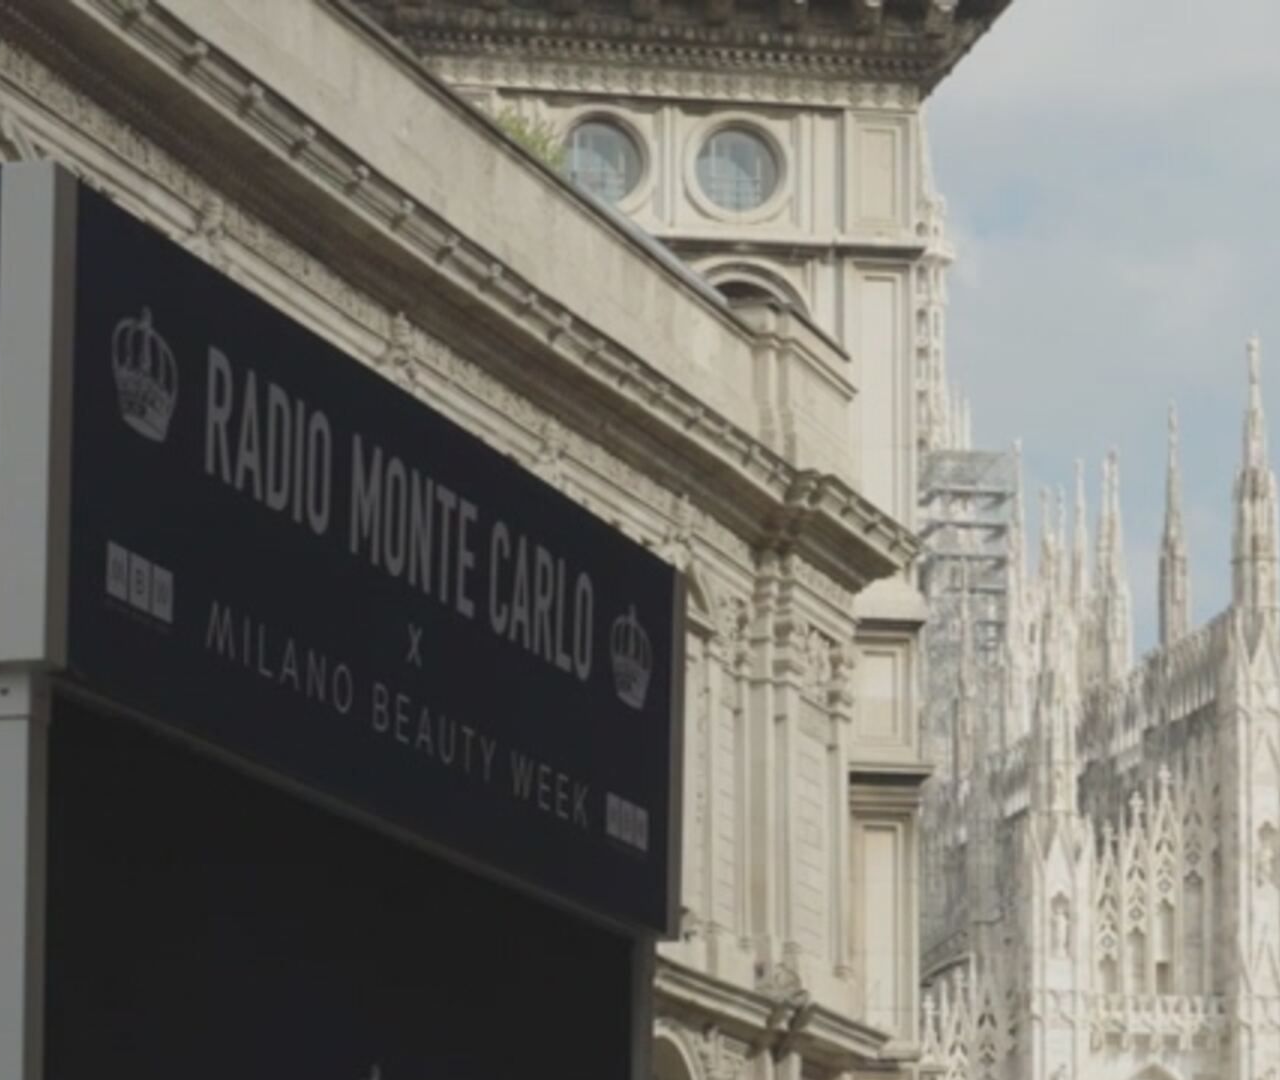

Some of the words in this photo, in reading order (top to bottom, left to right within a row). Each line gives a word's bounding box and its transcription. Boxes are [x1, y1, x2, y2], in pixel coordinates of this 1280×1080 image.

[205, 345, 333, 537] RADIO
[349, 432, 478, 621] MONTE
[489, 520, 594, 682] CARLO
[205, 599, 354, 716] MILANO
[371, 681, 498, 781] BEAUTY
[511, 750, 589, 829] WEEK
